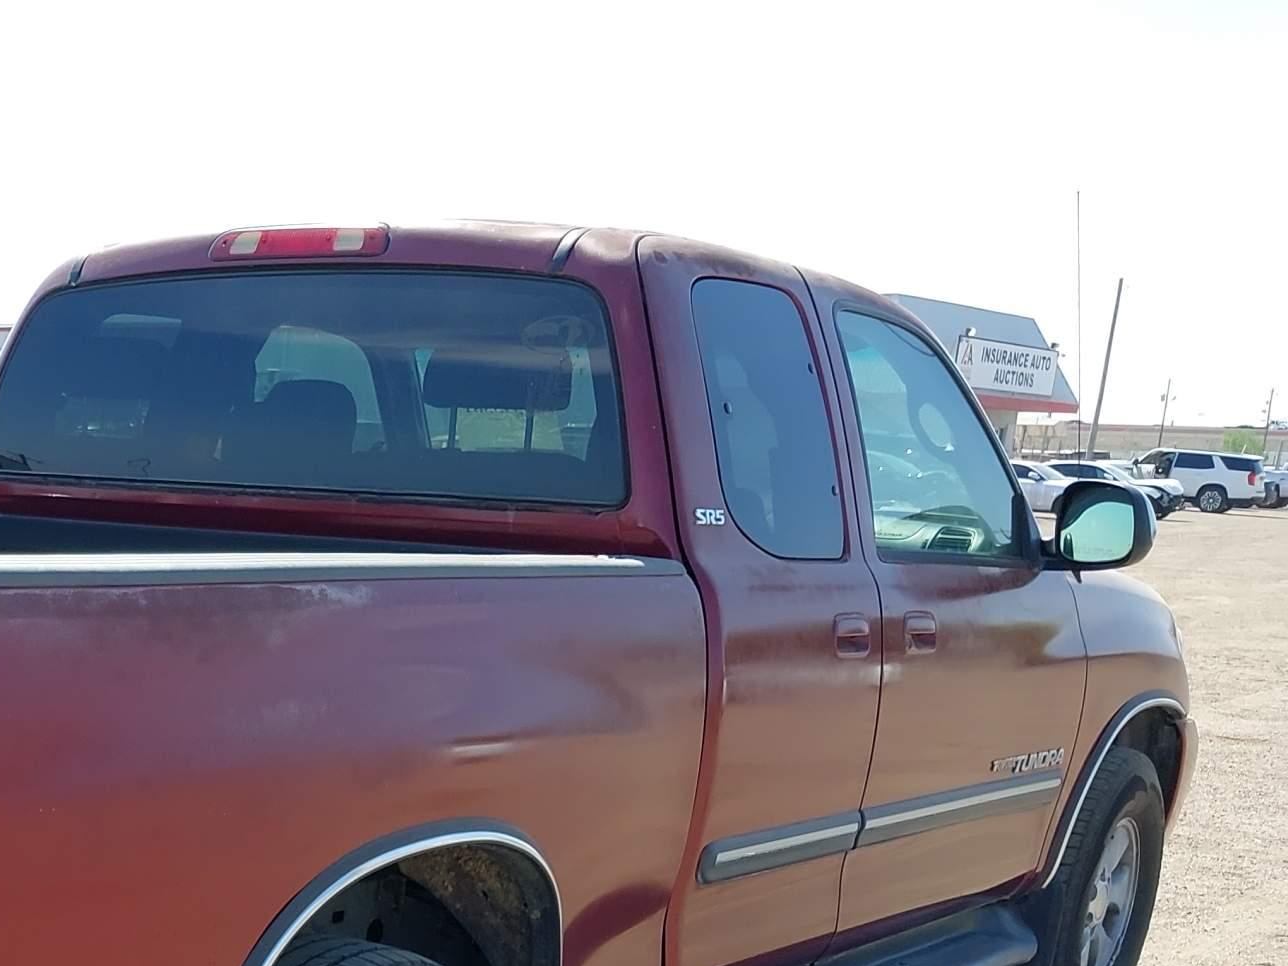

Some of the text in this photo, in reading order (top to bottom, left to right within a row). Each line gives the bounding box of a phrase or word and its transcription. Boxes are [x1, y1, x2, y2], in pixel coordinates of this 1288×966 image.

[981, 346, 1052, 371] INSURANCE AUTO
[993, 367, 1034, 388] AUCTIONS
[695, 508, 725, 525] SR5
[1013, 747, 1065, 773] TUNDRA
